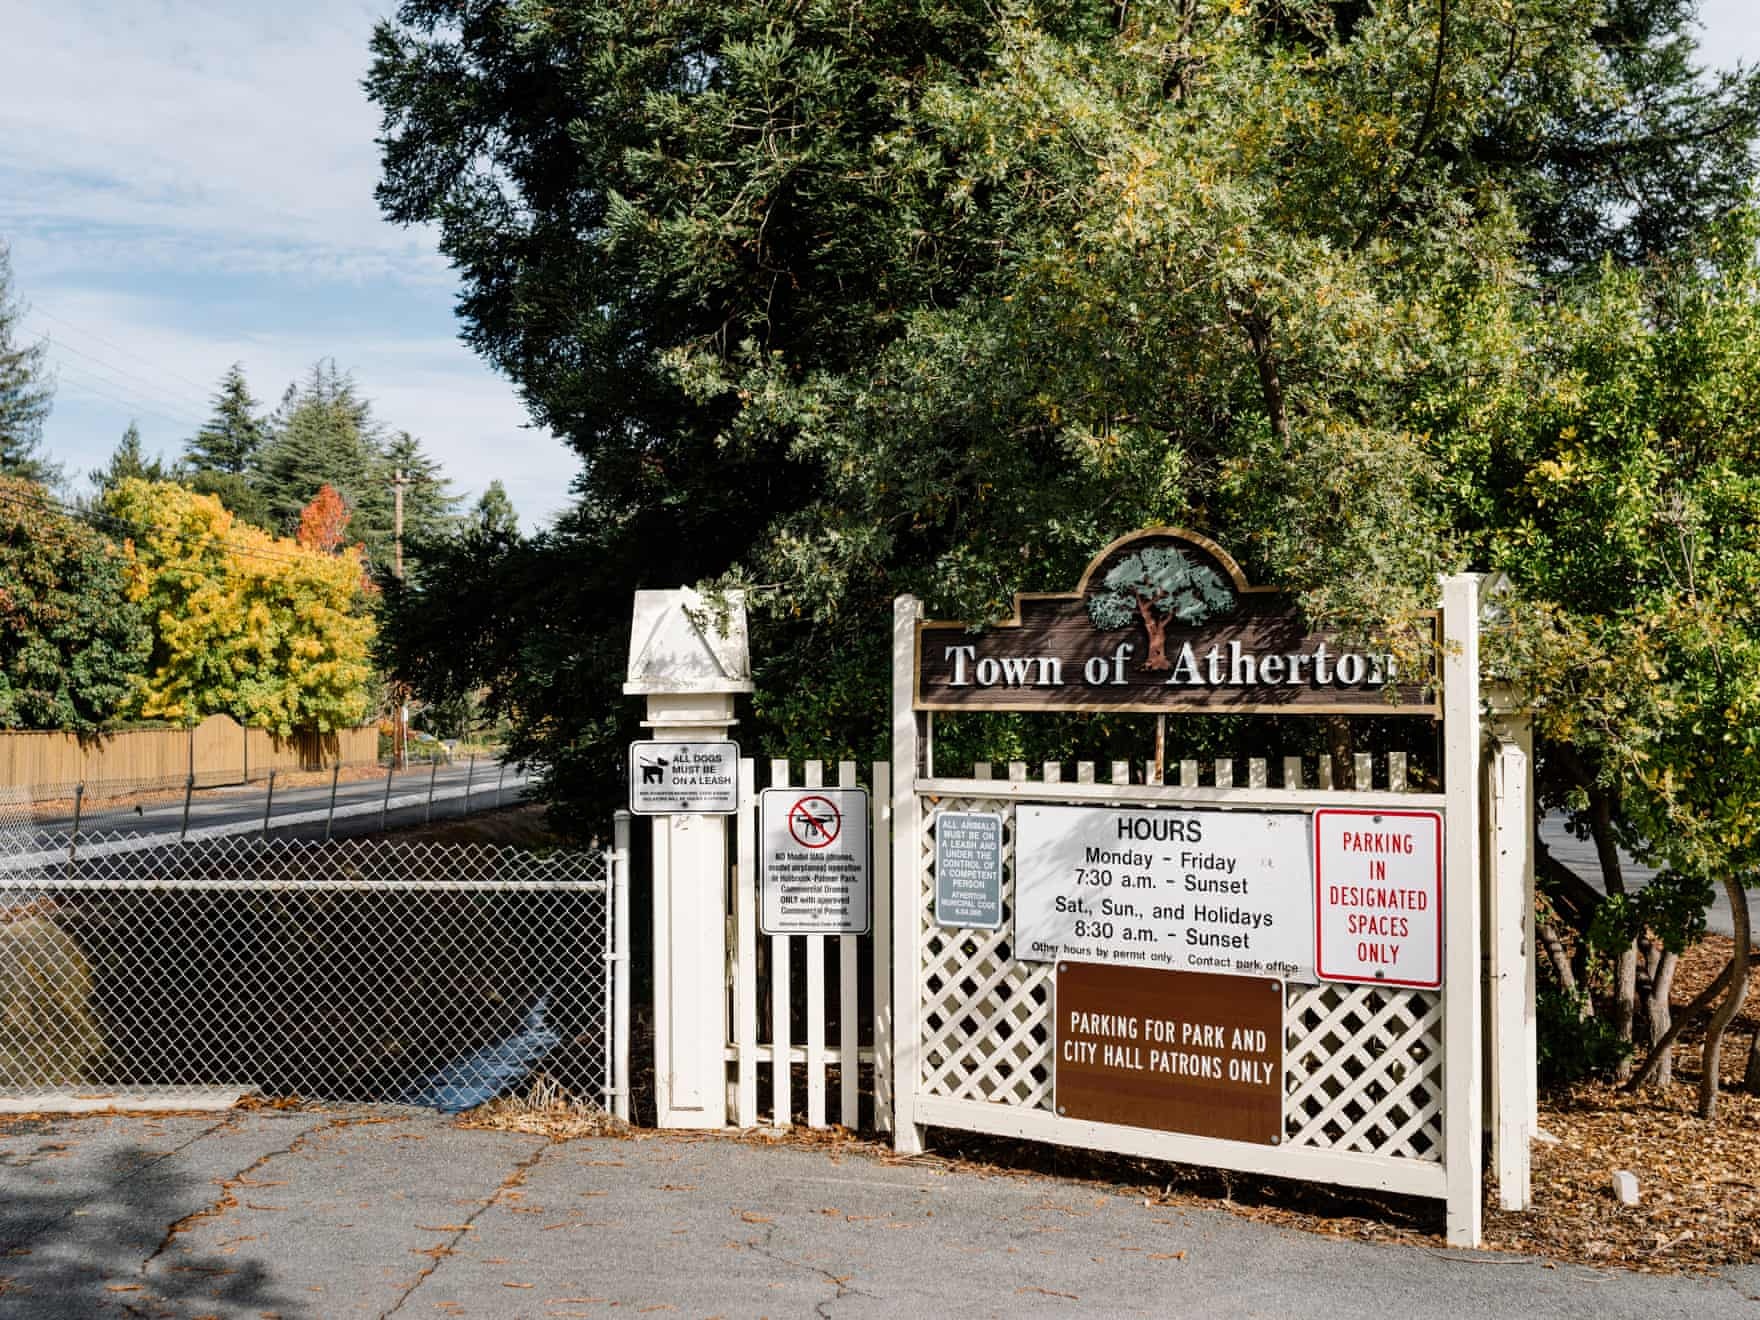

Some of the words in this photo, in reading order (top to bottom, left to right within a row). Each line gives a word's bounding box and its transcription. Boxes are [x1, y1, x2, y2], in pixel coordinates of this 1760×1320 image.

[944, 645, 1064, 687] Town
[1084, 643, 1133, 686] of
[672, 765, 700, 774] MUST
[704, 765, 716, 774] BE
[673, 754, 688, 763] ALL
[694, 754, 722, 763] DOGS
[672, 777, 687, 785] ON
[690, 777, 696, 785] A
[699, 776, 731, 785] LEASH
[942, 820, 957, 830] ALL
[961, 821, 996, 831] ANIMALS
[943, 830, 966, 840] MUST
[968, 831, 979, 840] BE
[982, 832, 994, 841] ON
[1117, 817, 1202, 843] HOURS
[942, 839, 948, 848] A
[951, 840, 977, 849] LEASH
[980, 841, 997, 850] AND
[1343, 831, 1413, 854] PARKING
[943, 859, 980, 869] CONTROL
[983, 860, 995, 870] OF
[945, 849, 973, 859] UNDER
[977, 850, 993, 860] THE
[1085, 847, 1153, 869] Monday
[1180, 851, 1237, 874] Friday
[941, 869, 946, 877] A
[949, 870, 997, 880] COMPETENT
[1075, 869, 1112, 887] 7:30
[1121, 874, 1156, 889] a.m.
[1184, 875, 1248, 895] Sunset
[1370, 860, 1386, 881] IN
[952, 879, 985, 889] PERSON
[1329, 886, 1428, 911] DESIGNATED
[1055, 896, 1093, 916] Sat.,
[1102, 899, 1144, 920] Sun.,
[1152, 904, 1185, 921] and
[1194, 905, 1273, 928] Holidays
[1075, 921, 1113, 939] 8:30
[1122, 926, 1158, 942] a.m.
[1186, 929, 1250, 949] Sunset
[1348, 914, 1409, 937] SPACES
[1031, 941, 1058, 953] Other
[1063, 944, 1091, 956] hours
[1096, 946, 1109, 959] by
[1113, 948, 1146, 961] permit
[1150, 951, 1175, 964] only.
[1188, 954, 1231, 968] Contact
[1236, 959, 1262, 971] park
[1357, 942, 1400, 965] ONLY
[1071, 1011, 1138, 1040] PARKING
[1145, 1019, 1175, 1044] FOR
[1182, 1023, 1225, 1049] PARK
[1231, 1028, 1267, 1053] AND
[1063, 1040, 1097, 1064] CITY
[1104, 1045, 1144, 1070] HALL
[1150, 1050, 1222, 1080] PATRONS
[1229, 1058, 1274, 1085] ONLY
